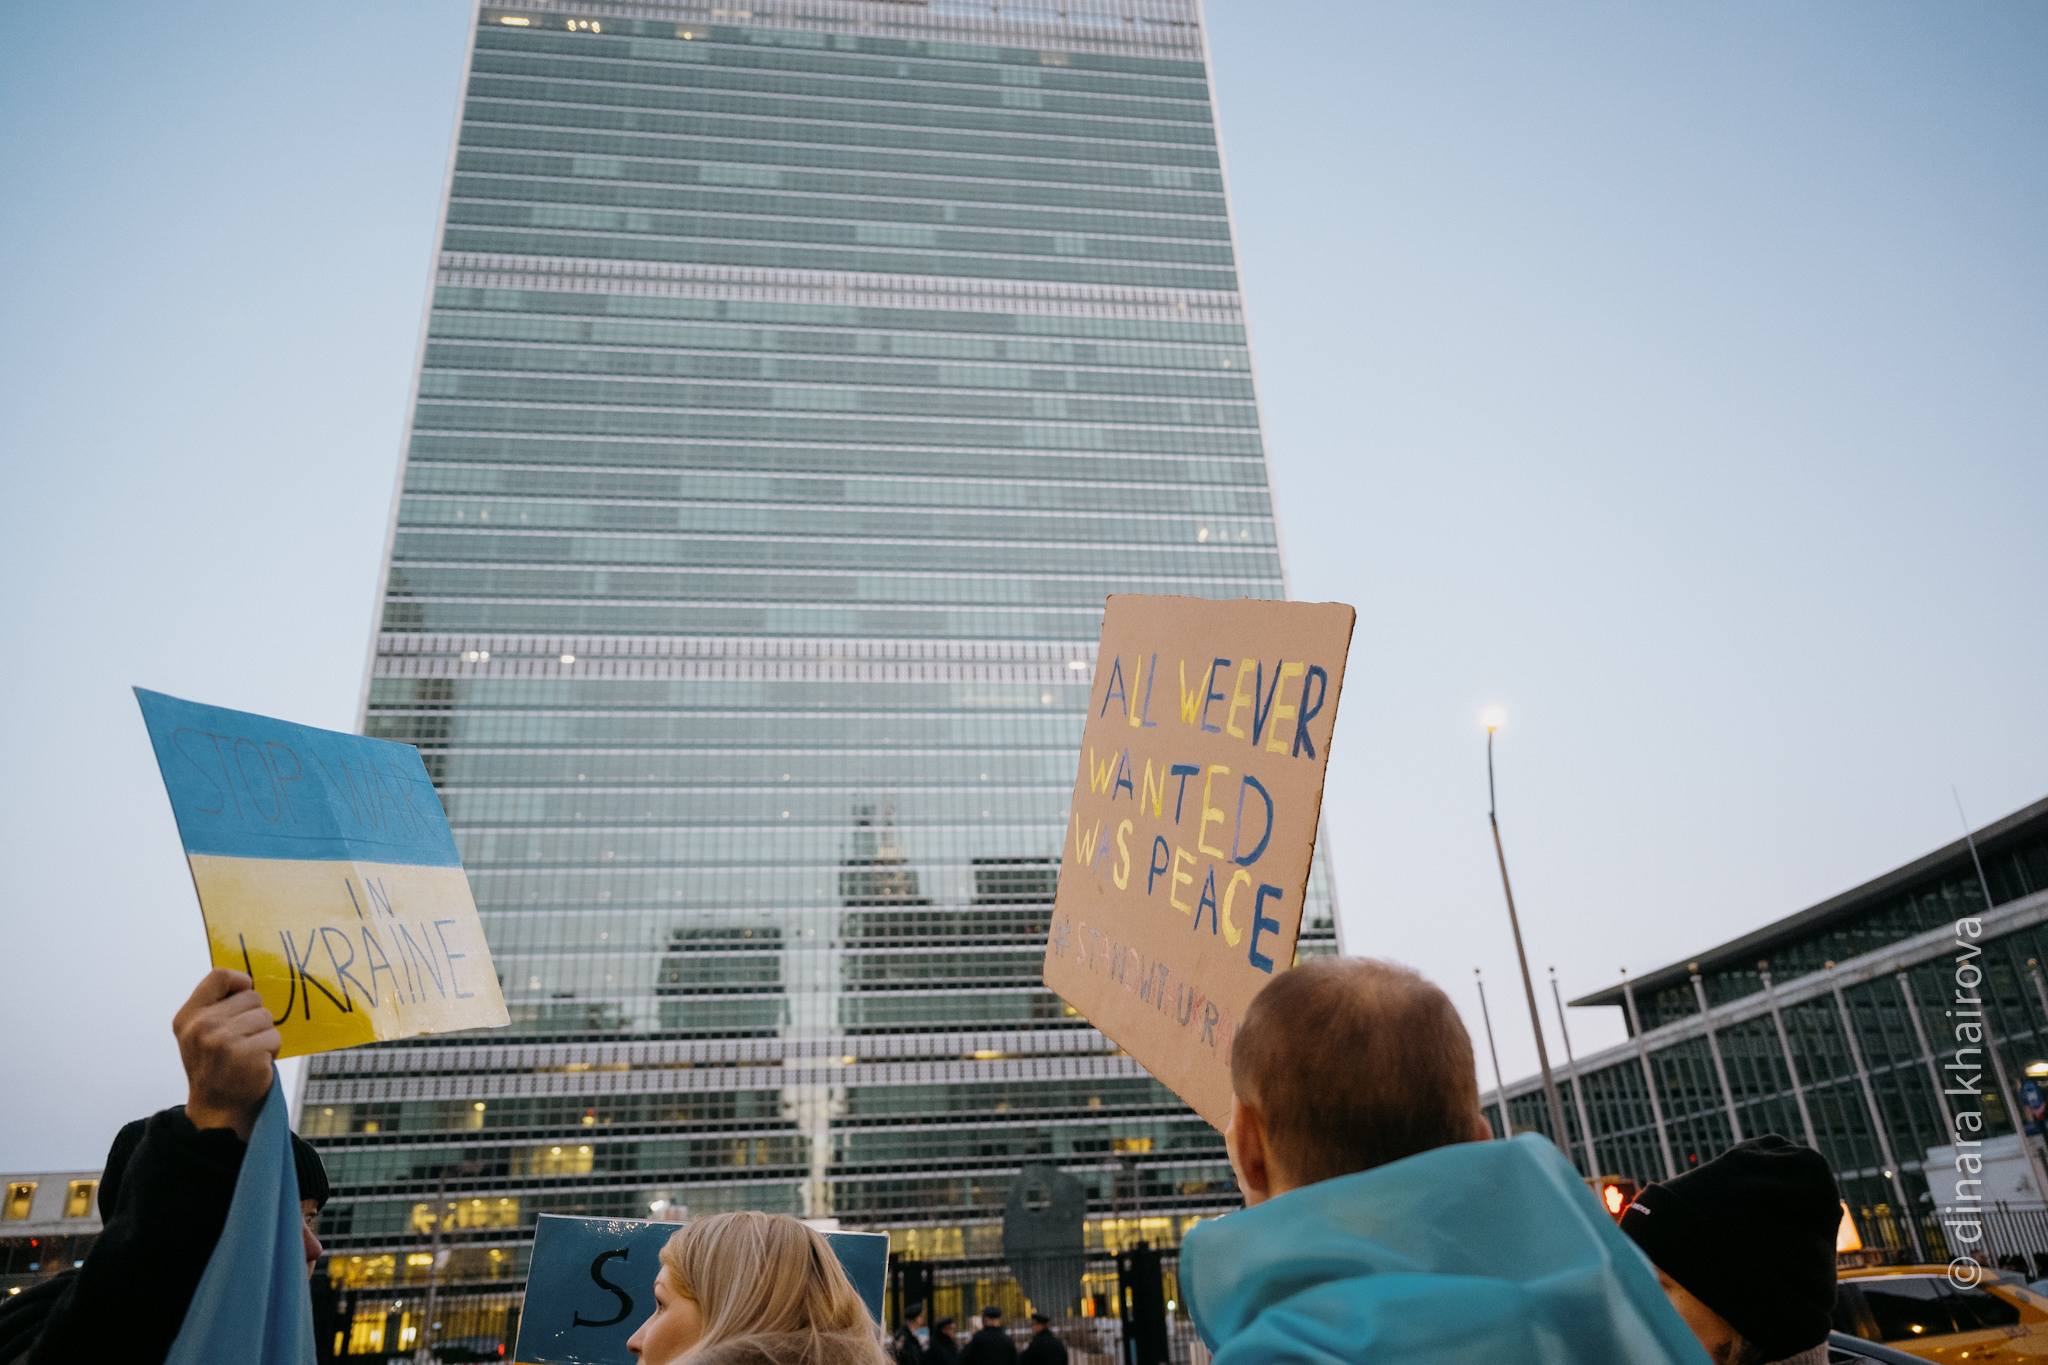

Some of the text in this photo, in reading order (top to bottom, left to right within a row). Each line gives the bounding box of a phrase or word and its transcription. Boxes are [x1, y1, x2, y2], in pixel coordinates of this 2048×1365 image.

[1101, 652, 1158, 728] ALL
[173, 727, 437, 837] STOP WAR
[1089, 746, 1274, 867] WANTED
[344, 877, 396, 920] IN
[1075, 812, 1284, 974] WAS PEACE
[239, 919, 475, 1026] UKRAINE
